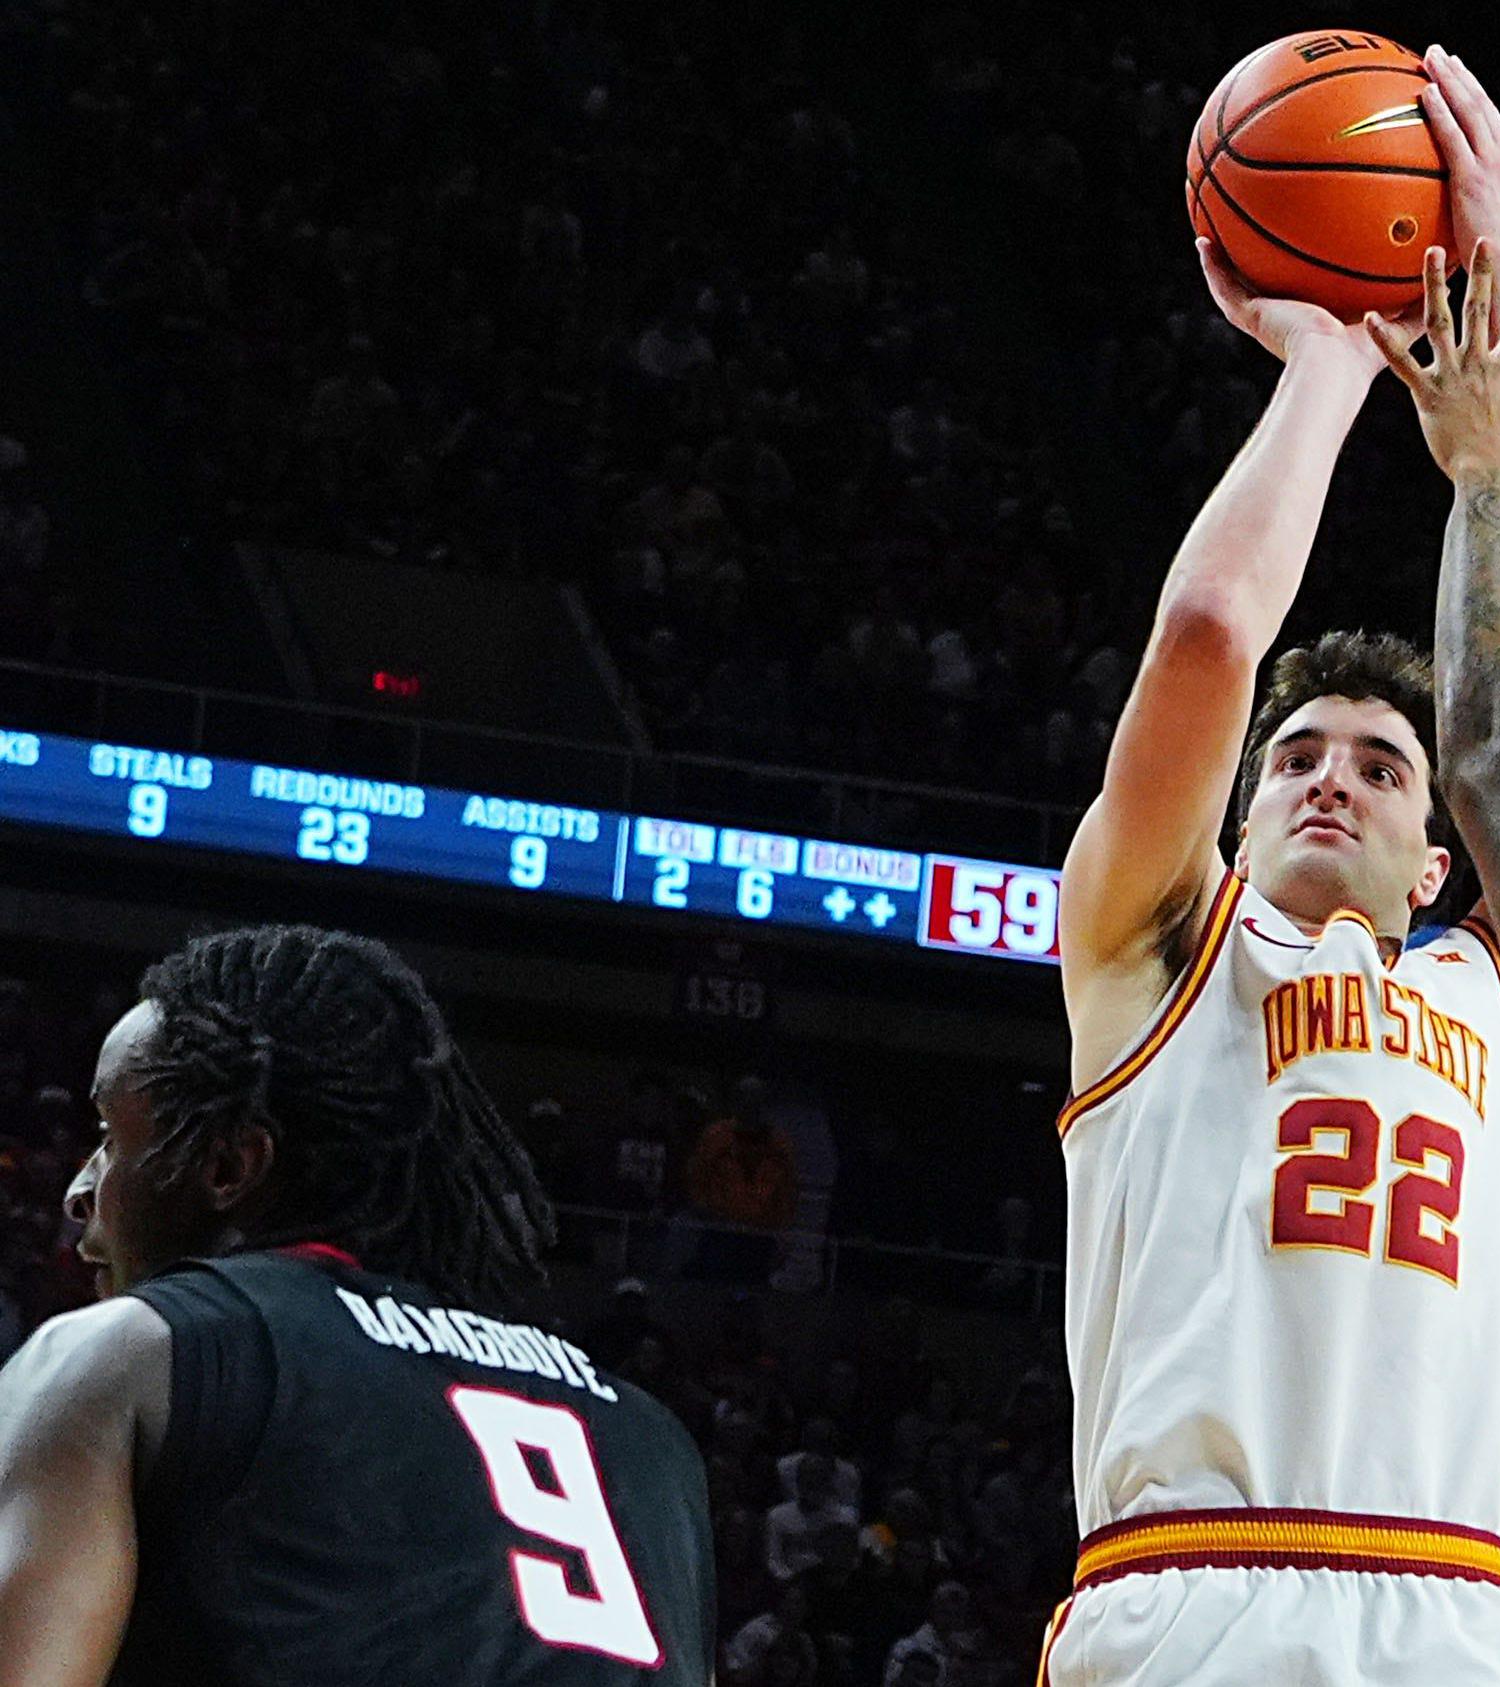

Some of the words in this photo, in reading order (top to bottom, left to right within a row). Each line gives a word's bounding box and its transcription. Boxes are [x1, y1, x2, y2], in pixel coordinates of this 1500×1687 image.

[89, 743, 213, 790] STEALS
[251, 765, 426, 819] REBOUNDS
[127, 783, 168, 838] 9
[297, 806, 370, 865] 23
[462, 796, 600, 843] ASSISTS
[509, 835, 548, 889] 9
[652, 857, 690, 909] 2
[815, 845, 911, 880] BONUS
[736, 869, 775, 919] 6
[949, 865, 1057, 955] 59
[1262, 973, 1371, 1085] IOWA
[1381, 976, 1489, 1123] STATE
[1270, 1096, 1466, 1290] 22
[444, 1382, 666, 1671] 9
